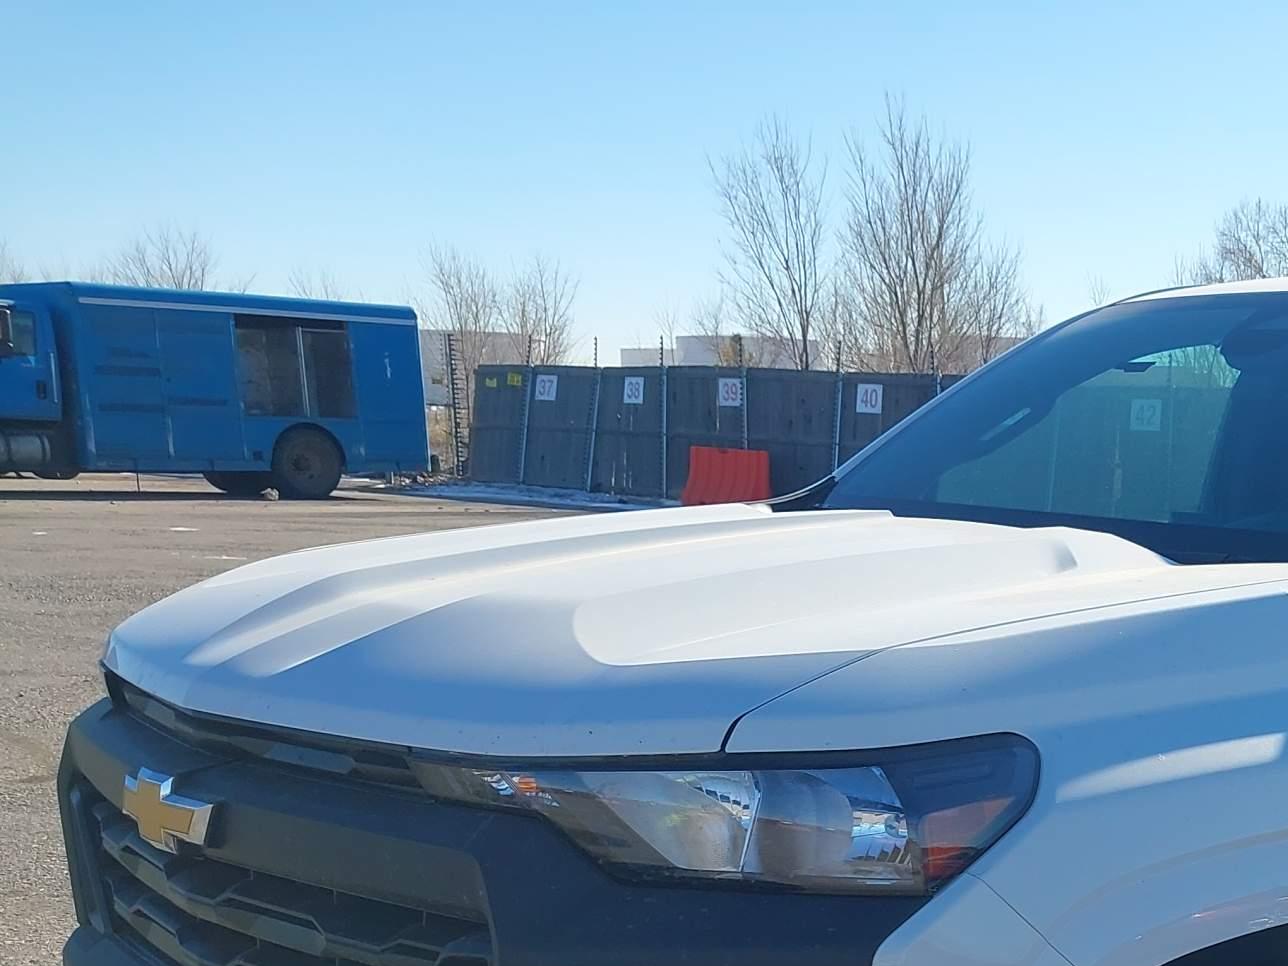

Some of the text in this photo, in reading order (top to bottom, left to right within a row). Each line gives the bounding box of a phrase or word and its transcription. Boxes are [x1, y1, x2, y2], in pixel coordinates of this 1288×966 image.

[538, 379, 554, 396] 37
[626, 381, 641, 399] 38
[722, 383, 739, 401] 39
[860, 388, 879, 408] 40
[1135, 404, 1157, 425] 42
